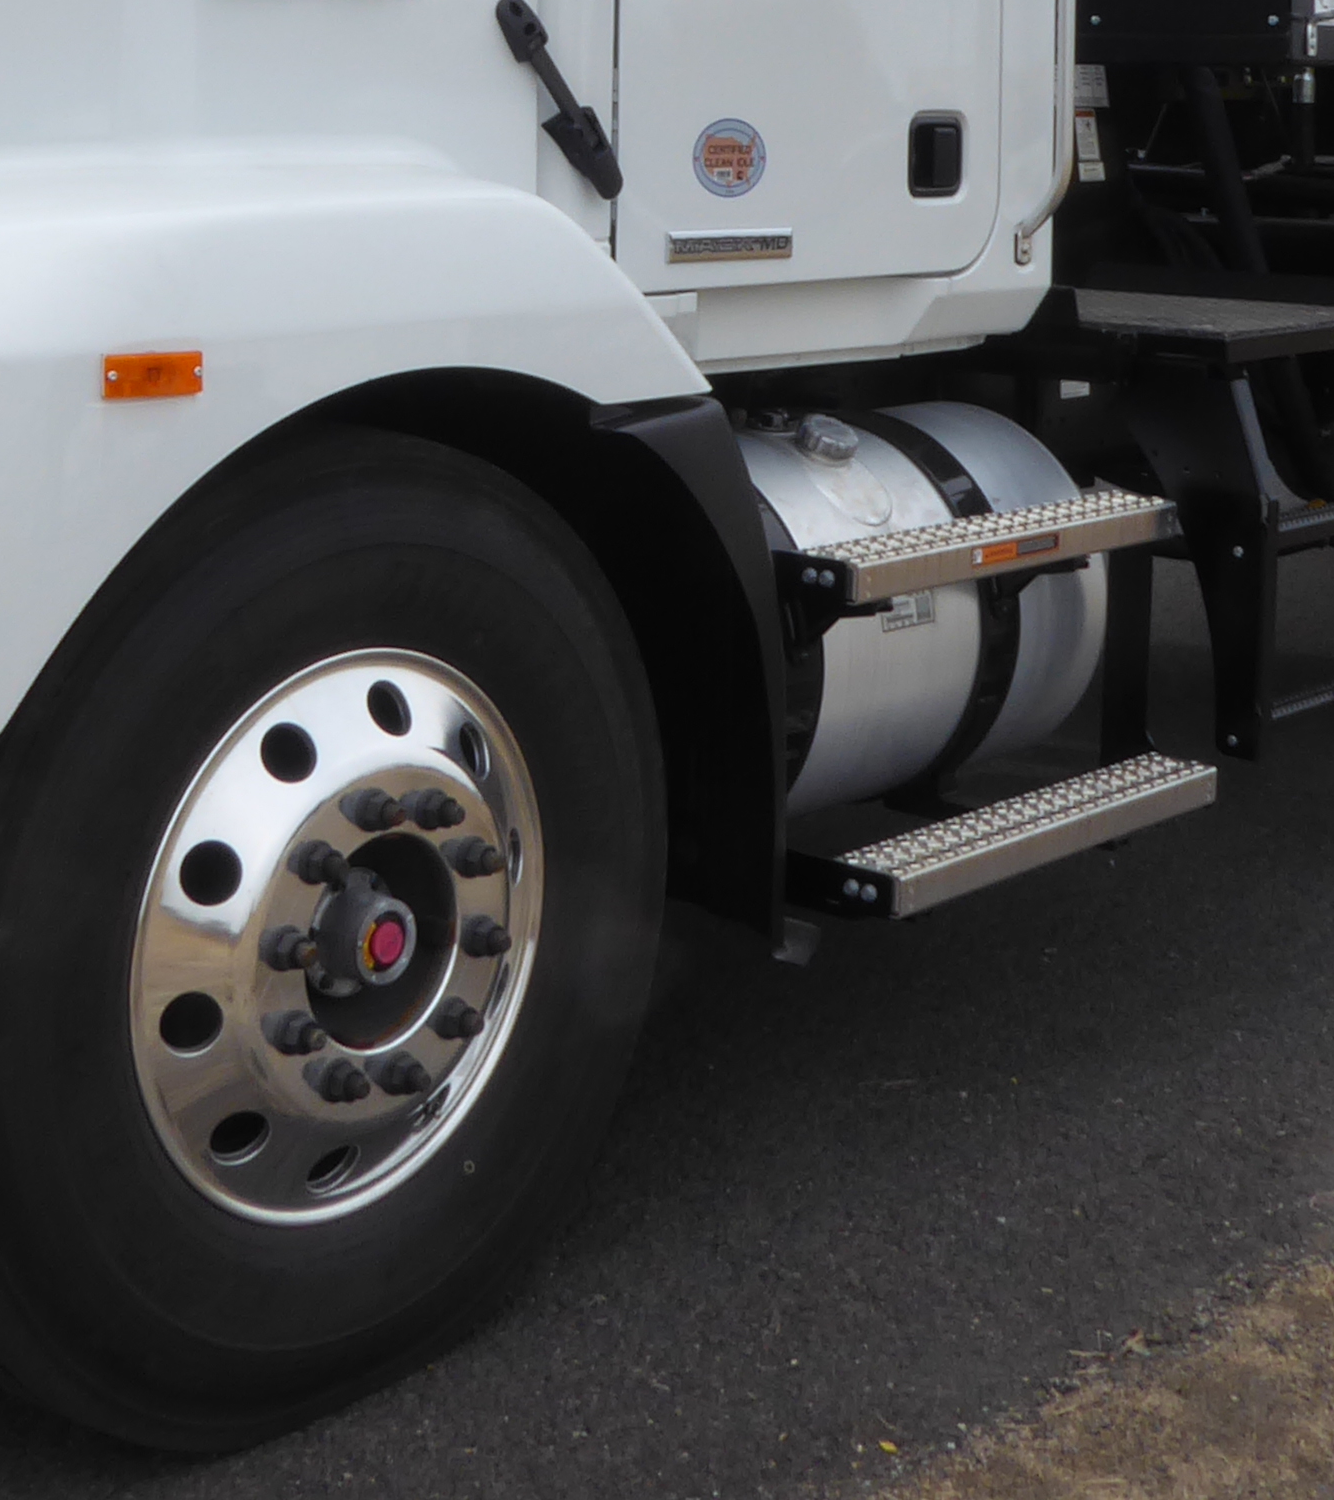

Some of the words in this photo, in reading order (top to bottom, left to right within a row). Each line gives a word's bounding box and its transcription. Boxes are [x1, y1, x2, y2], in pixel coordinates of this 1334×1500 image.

[708, 145, 752, 155] CERTIFIED
[704, 158, 733, 168] CLEAN
[674, 239, 753, 254] MACK
[759, 237, 789, 251] MD
